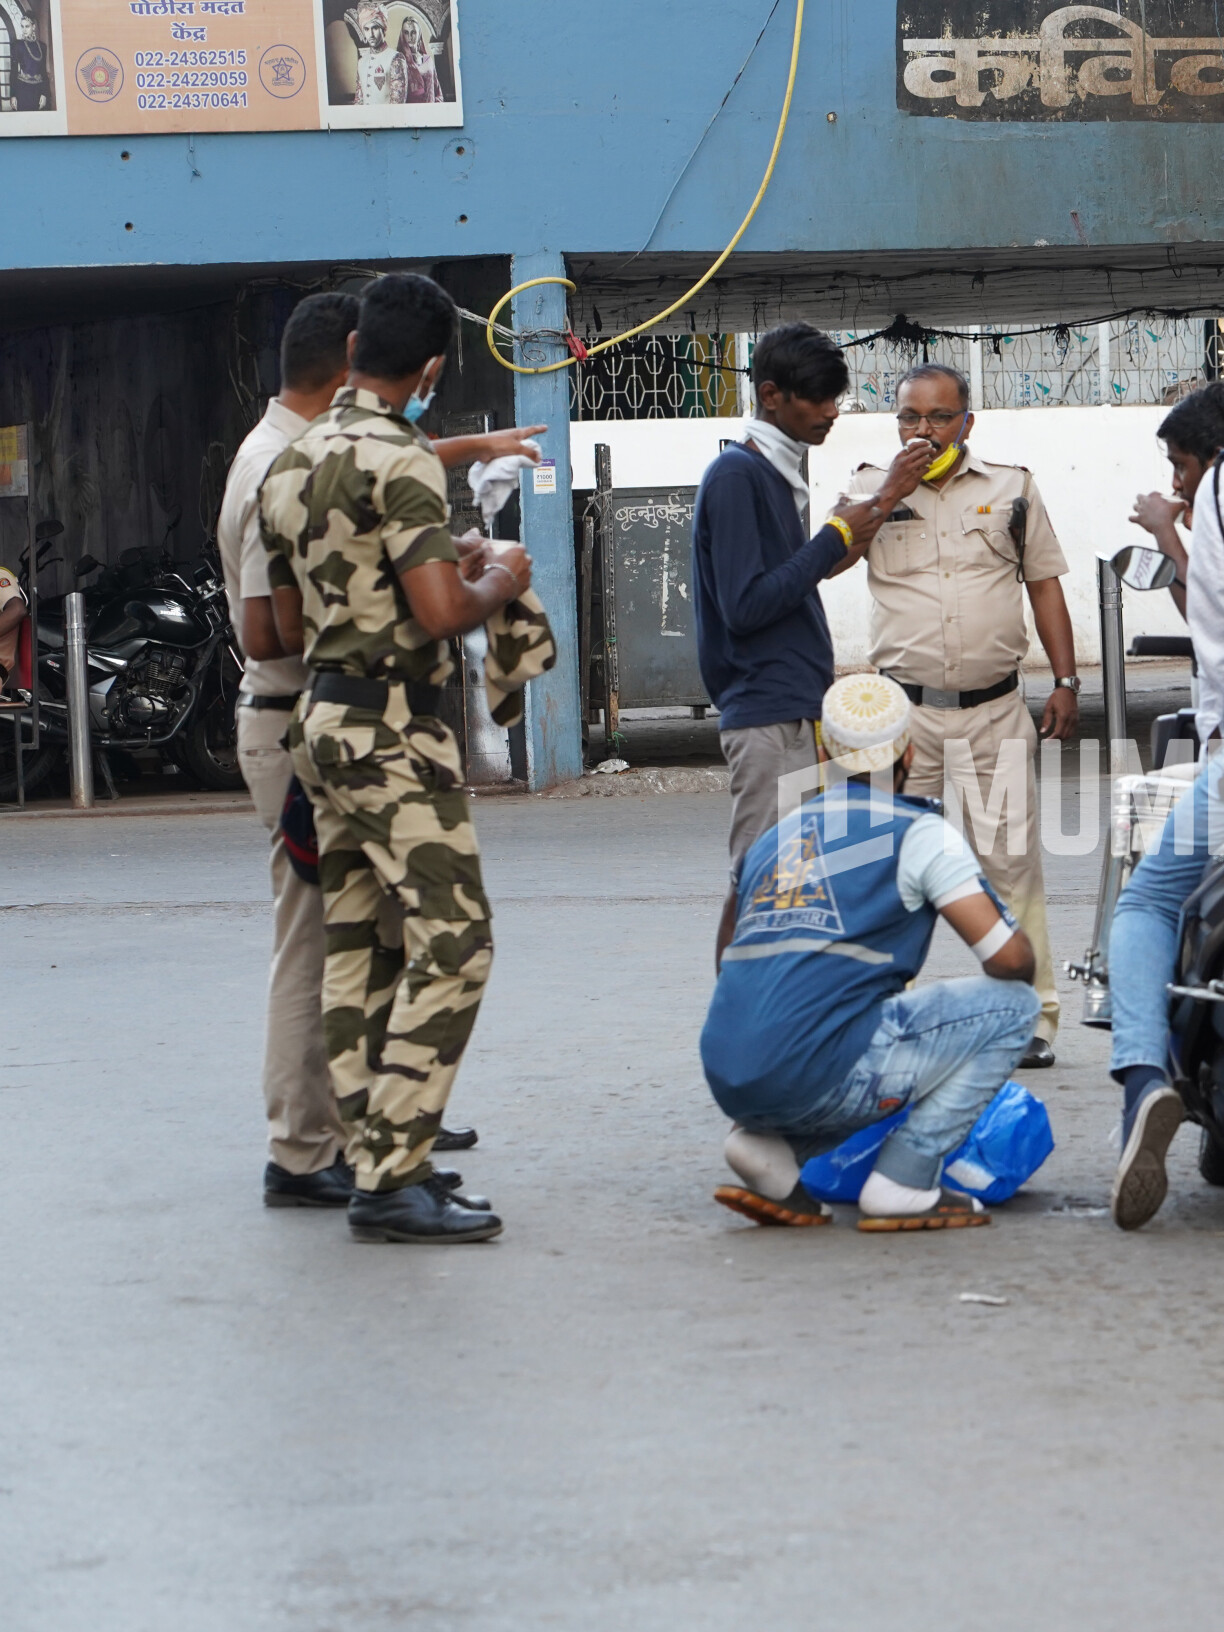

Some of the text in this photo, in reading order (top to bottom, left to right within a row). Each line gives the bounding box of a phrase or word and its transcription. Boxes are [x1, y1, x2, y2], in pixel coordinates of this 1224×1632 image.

[199, 1, 245, 15] मदत
[171, 22, 206, 41] केंद्र
[135, 50, 247, 67] 022-24362515
[136, 71, 248, 88] 022-24229059
[137, 92, 249, 109] 022-24370641
